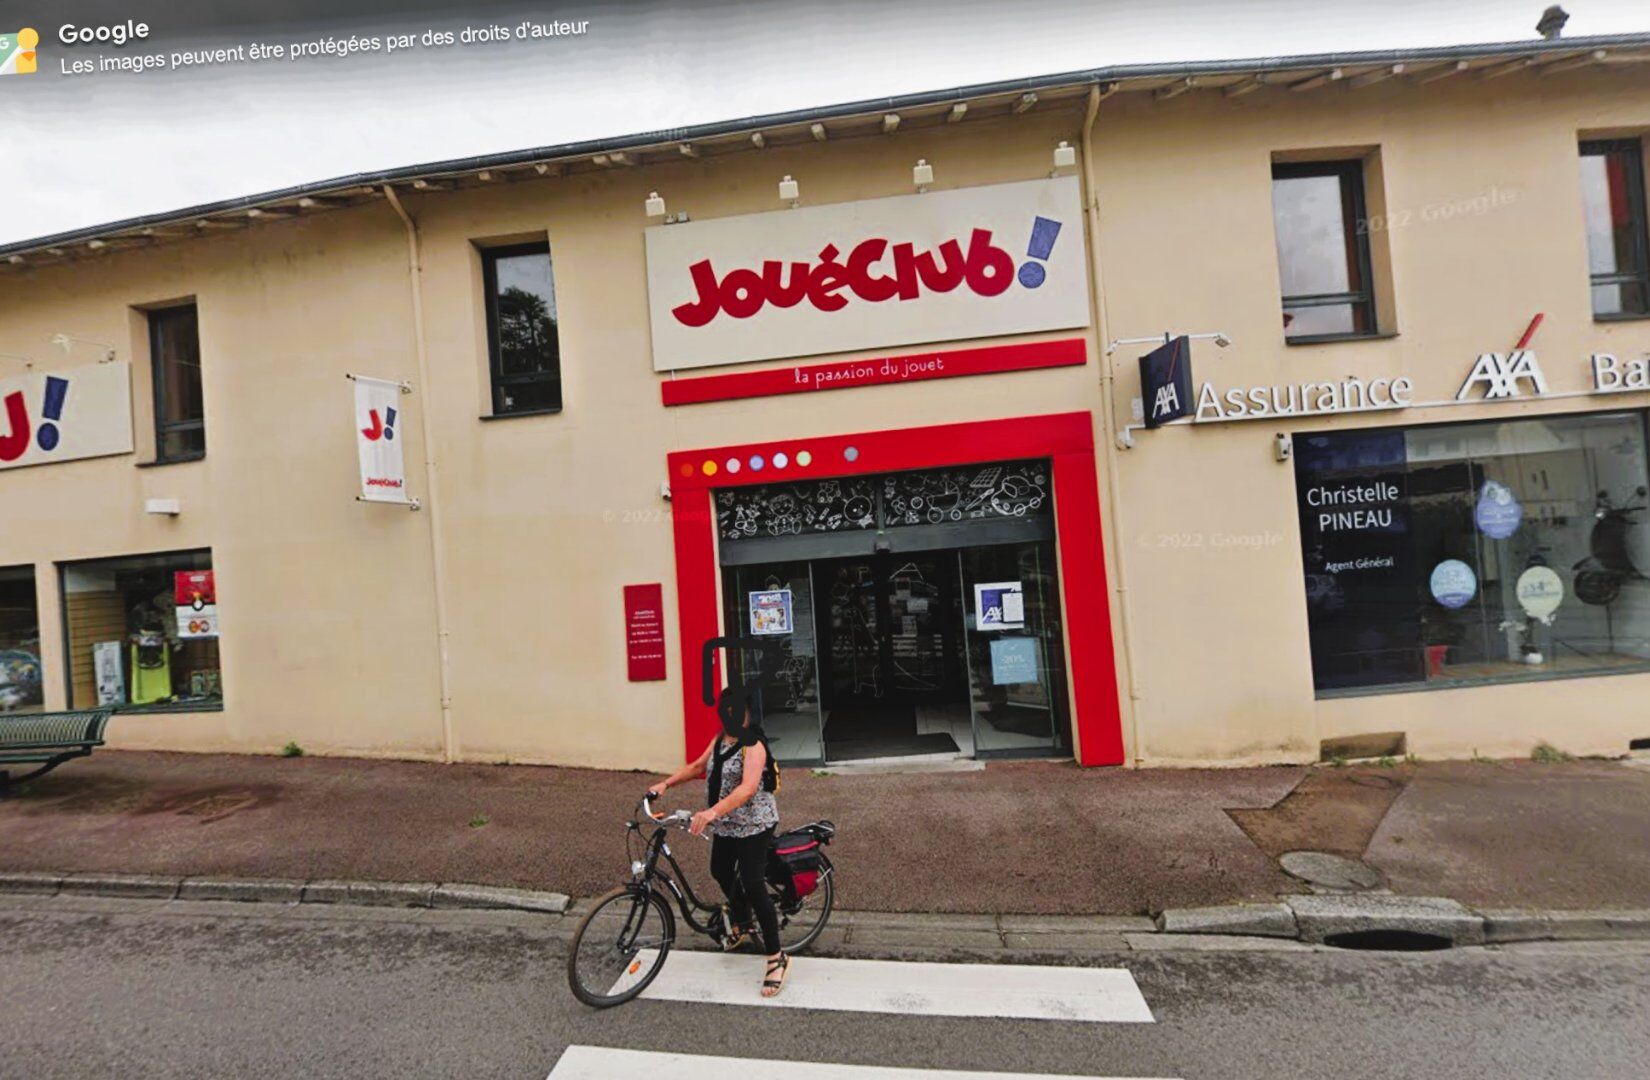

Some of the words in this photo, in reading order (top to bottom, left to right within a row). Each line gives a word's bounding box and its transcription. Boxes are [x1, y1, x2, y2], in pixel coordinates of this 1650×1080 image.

[795, 367, 809, 384] la
[815, 363, 875, 390] passion
[880, 361, 898, 377] du
[902, 357, 944, 377] jouet
[1195, 376, 1413, 421] Assurance
[1456, 349, 1547, 402] AXA
[1591, 352, 1650, 394] Ba
[1152, 381, 1181, 420] AXA
[1306, 481, 1399, 507] Christelle
[1319, 508, 1392, 532] PINEAU
[1324, 560, 1355, 573] Agent
[1355, 556, 1395, 570] Général
